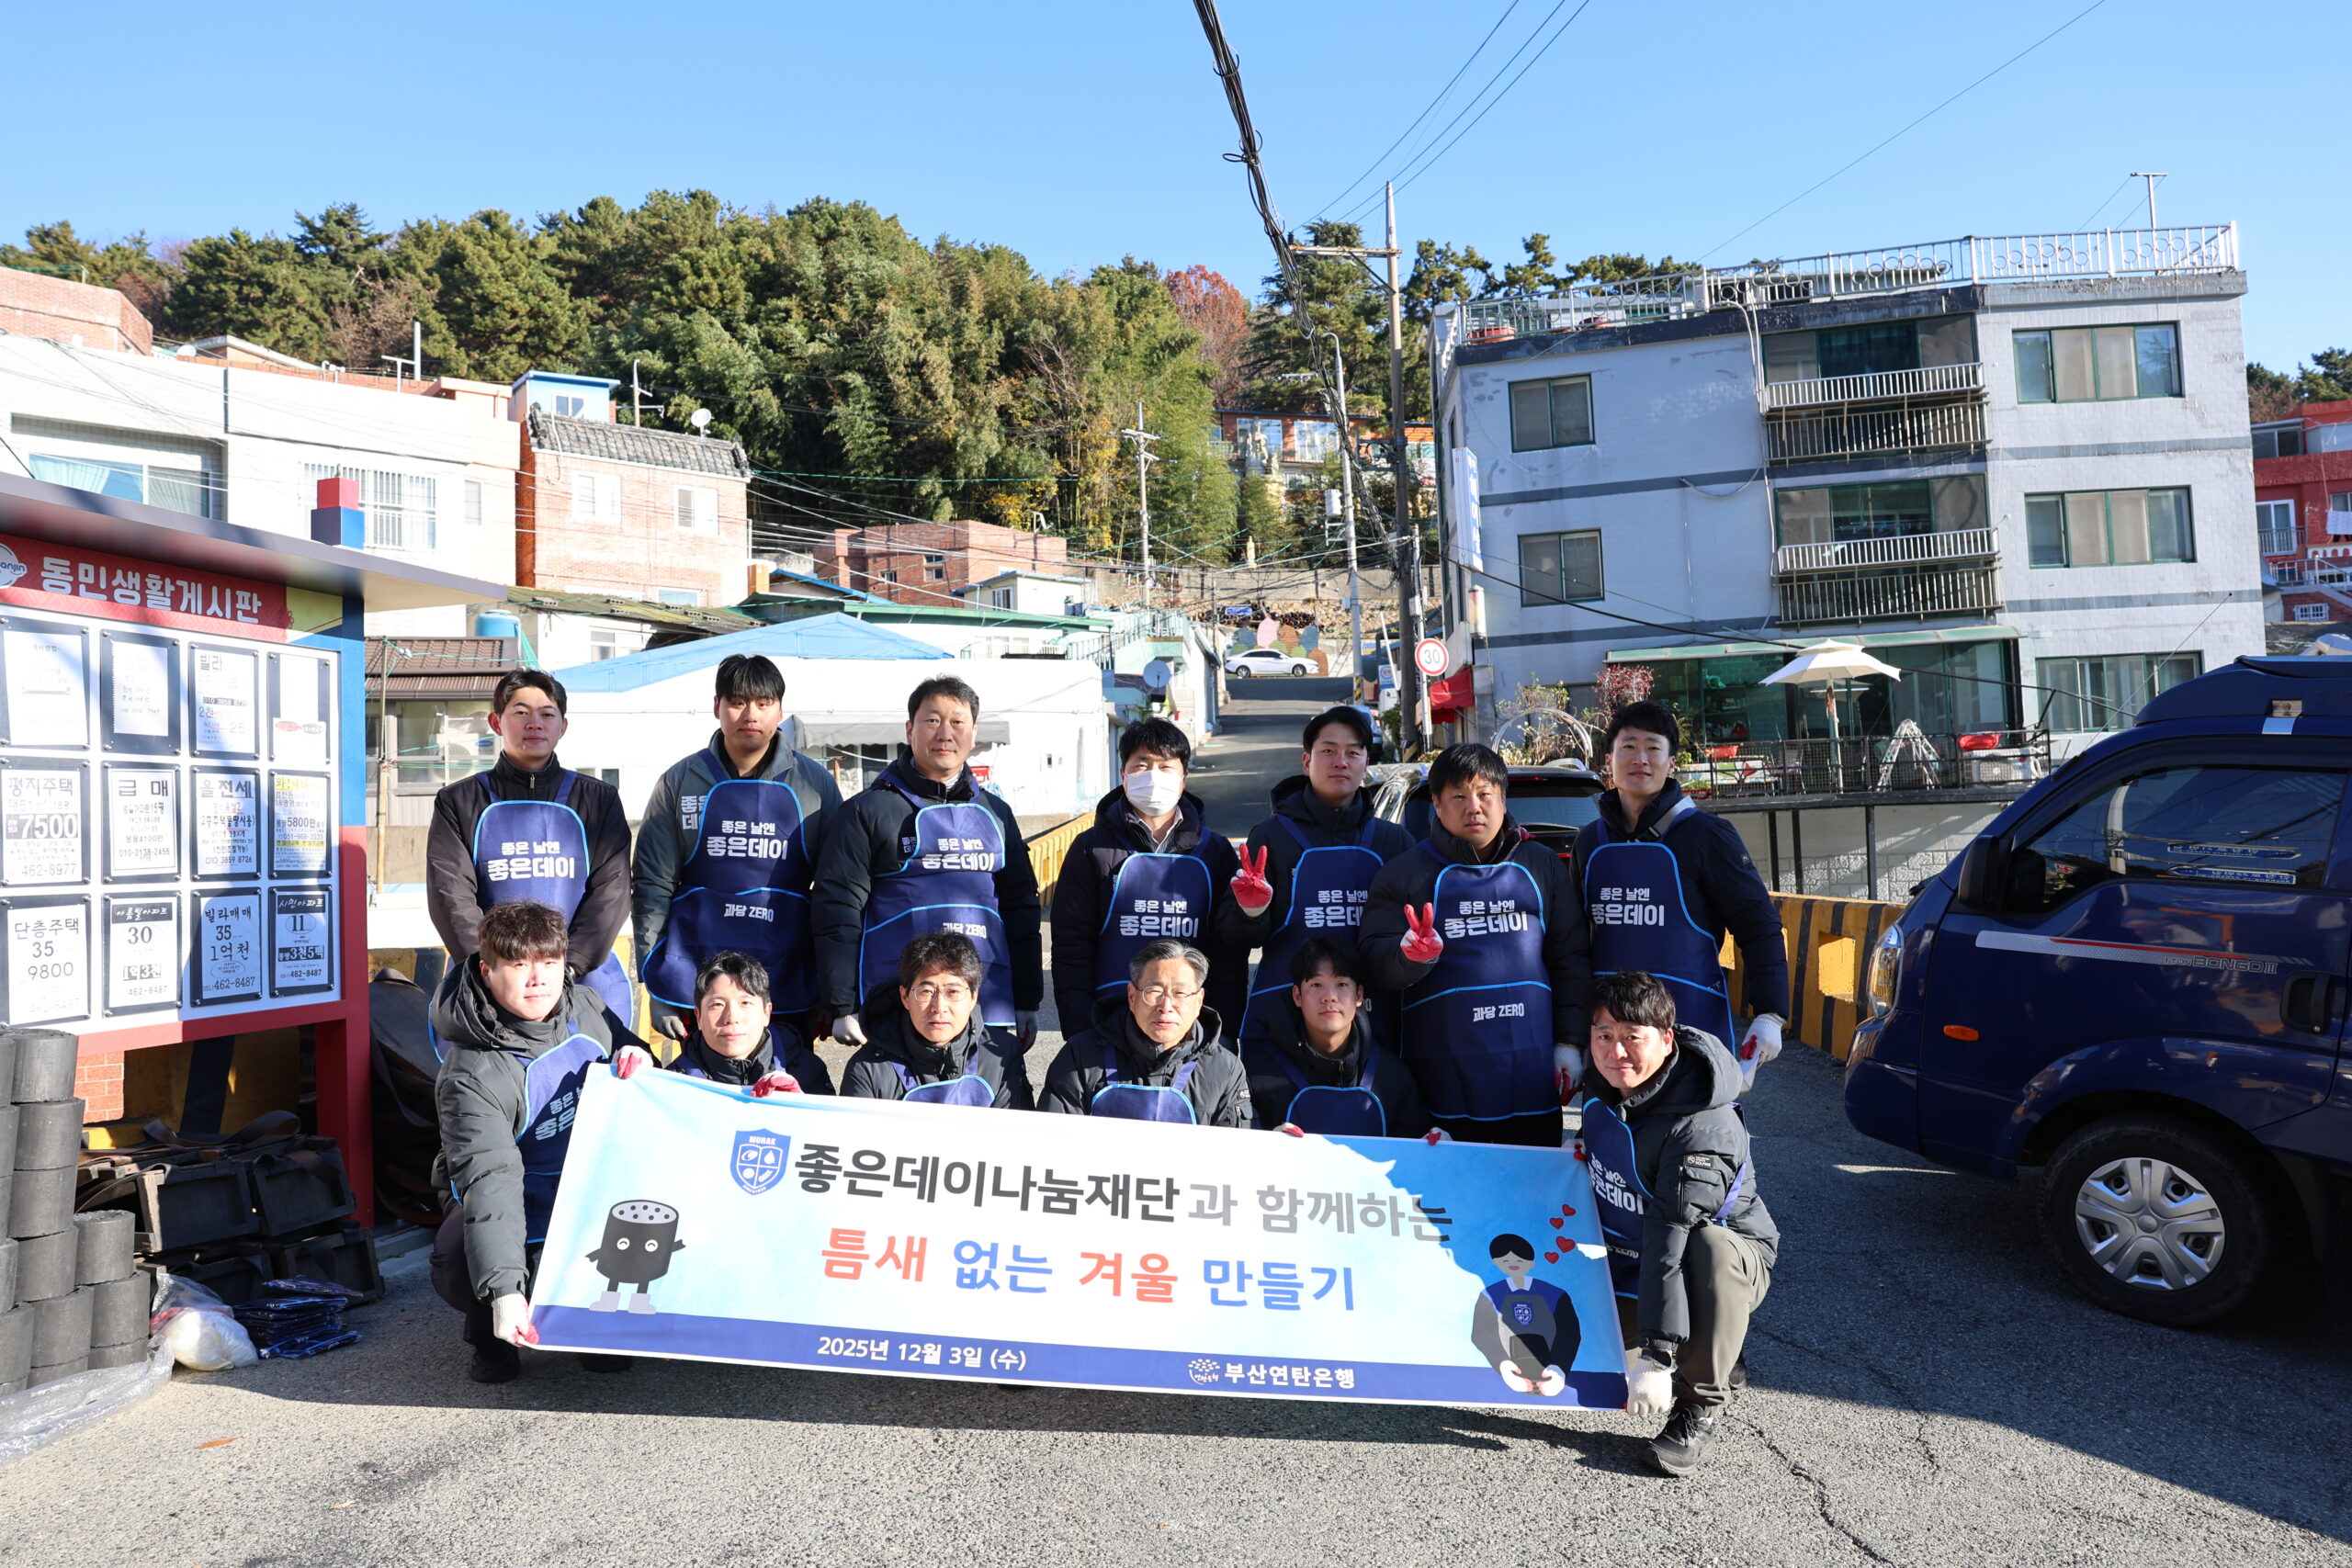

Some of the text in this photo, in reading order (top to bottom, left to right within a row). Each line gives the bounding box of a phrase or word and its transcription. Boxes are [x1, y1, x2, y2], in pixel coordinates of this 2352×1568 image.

[0, 561, 26, 572] anjin
[40, 556, 262, 624] 동민생활게시판
[1424, 649, 1440, 664] 30
[8, 777, 74, 797] 평지주택
[19, 814, 78, 839] 7500
[682, 813, 701, 830] 데
[722, 820, 775, 836] 좋은 날엔
[502, 840, 560, 855] 좋은 날엔
[707, 836, 788, 860] 좋은데이
[938, 838, 984, 852] 좋은 날엔
[487, 856, 575, 882] 좋은데이
[922, 852, 995, 871] 좋은데이
[1317, 889, 1368, 904] 좋은 날엔
[1600, 887, 1650, 901] 좋은 날엔
[205, 906, 252, 923] 빌라매매
[724, 903, 774, 922] 과당 ZERO
[1134, 899, 1187, 914] 좋은 날엔
[1459, 899, 1515, 915] 좋은 날엔
[1590, 903, 1665, 927] 좋은데이
[291, 915, 305, 931] 11
[1119, 915, 1199, 938] 좋은데이
[1304, 906, 1364, 928] 좋은데
[1444, 911, 1528, 939] 좋은데이
[15, 918, 79, 940] 단층주택
[127, 926, 153, 944] 30
[216, 925, 232, 941] 35
[965, 923, 988, 939] ZERO
[32, 941, 54, 958] 35
[28, 962, 74, 980] 9800
[2193, 955, 2265, 974] BONGO
[1473, 1002, 1524, 1022] 과당 ZERO
[549, 1090, 574, 1115] 좋은
[749, 1135, 776, 1145] MUHAK
[1256, 1184, 1453, 1242] 함께하는
[821, 1227, 1354, 1312] 틈새 없는 겨울 만들기
[817, 1336, 1027, 1371] 2025년 12월 3일 (수)
[1224, 1362, 1356, 1390] 부산연탄은행
